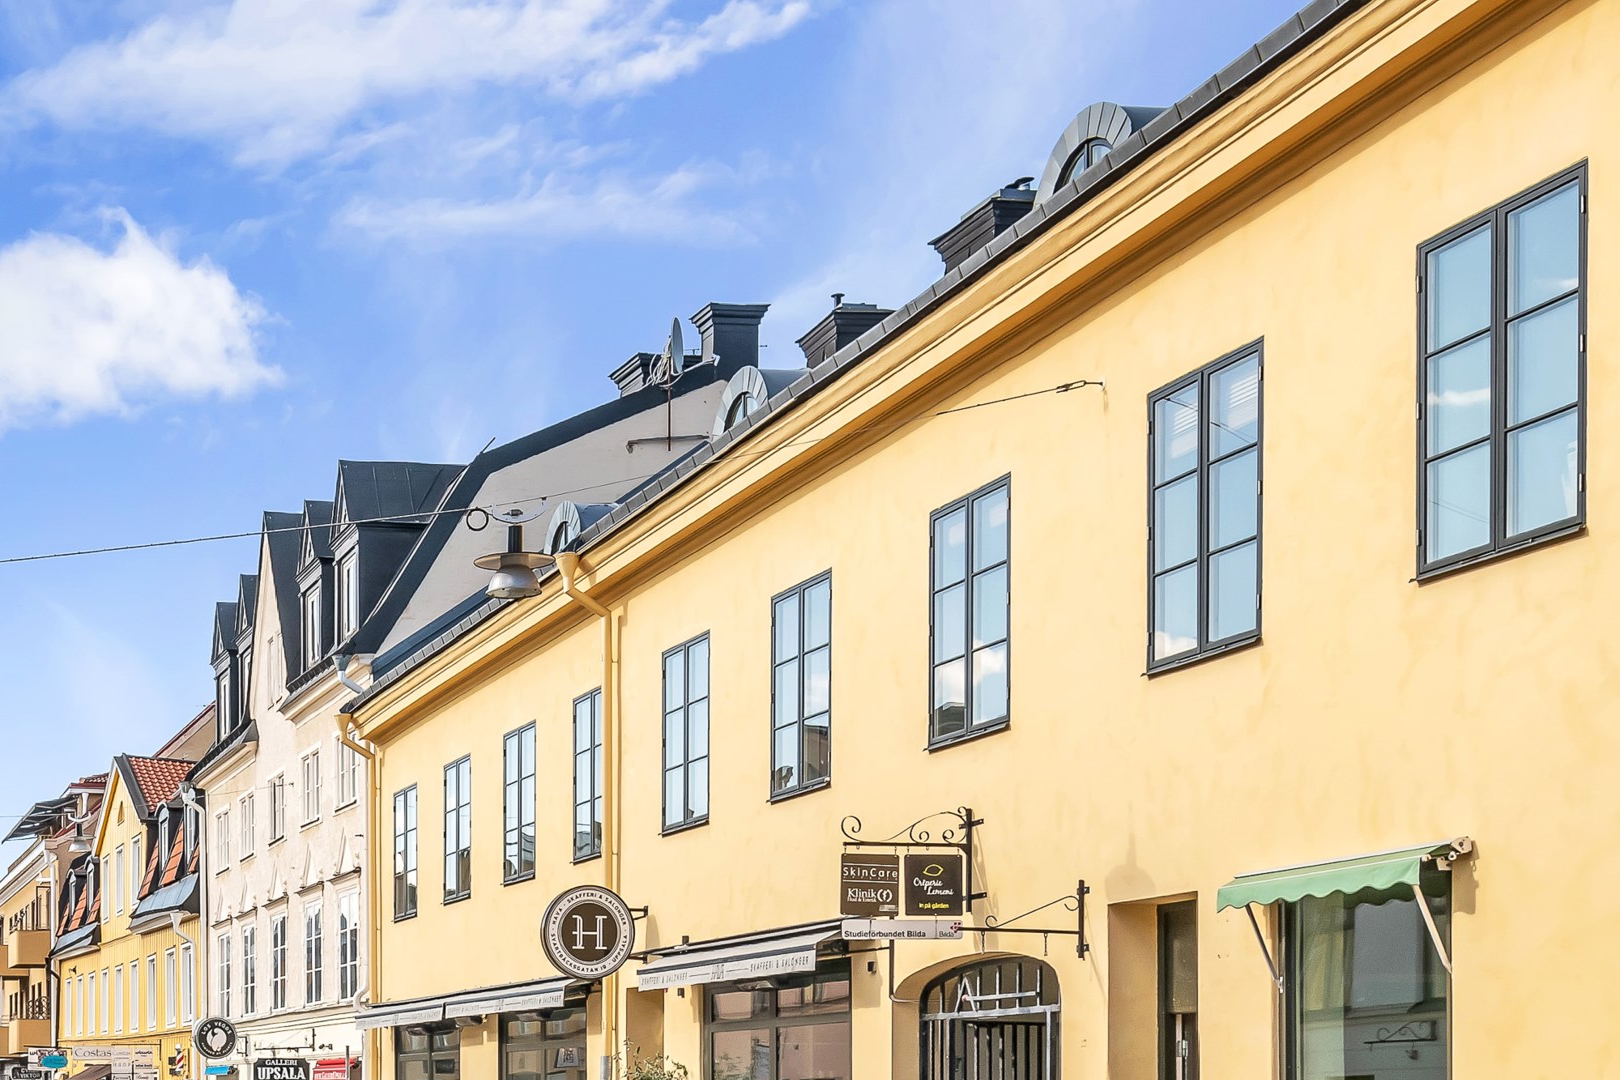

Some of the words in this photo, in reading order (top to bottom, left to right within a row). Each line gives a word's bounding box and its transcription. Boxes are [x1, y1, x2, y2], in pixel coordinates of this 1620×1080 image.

[843, 866, 898, 878] SkinCare
[847, 888, 877, 898] Klinik
[567, 892, 597, 903] SKAFFERI
[605, 896, 627, 926] SALONGER
[552, 908, 562, 925] HAVA
[572, 914, 608, 950] H
[844, 930, 906, 938] Studieförbundet
[906, 930, 927, 938] Bilda
[938, 930, 955, 938] Bilda
[612, 934, 628, 963] UPPSALA
[74, 1048, 112, 1058] Costas
[257, 1067, 306, 1080] UPSALA
